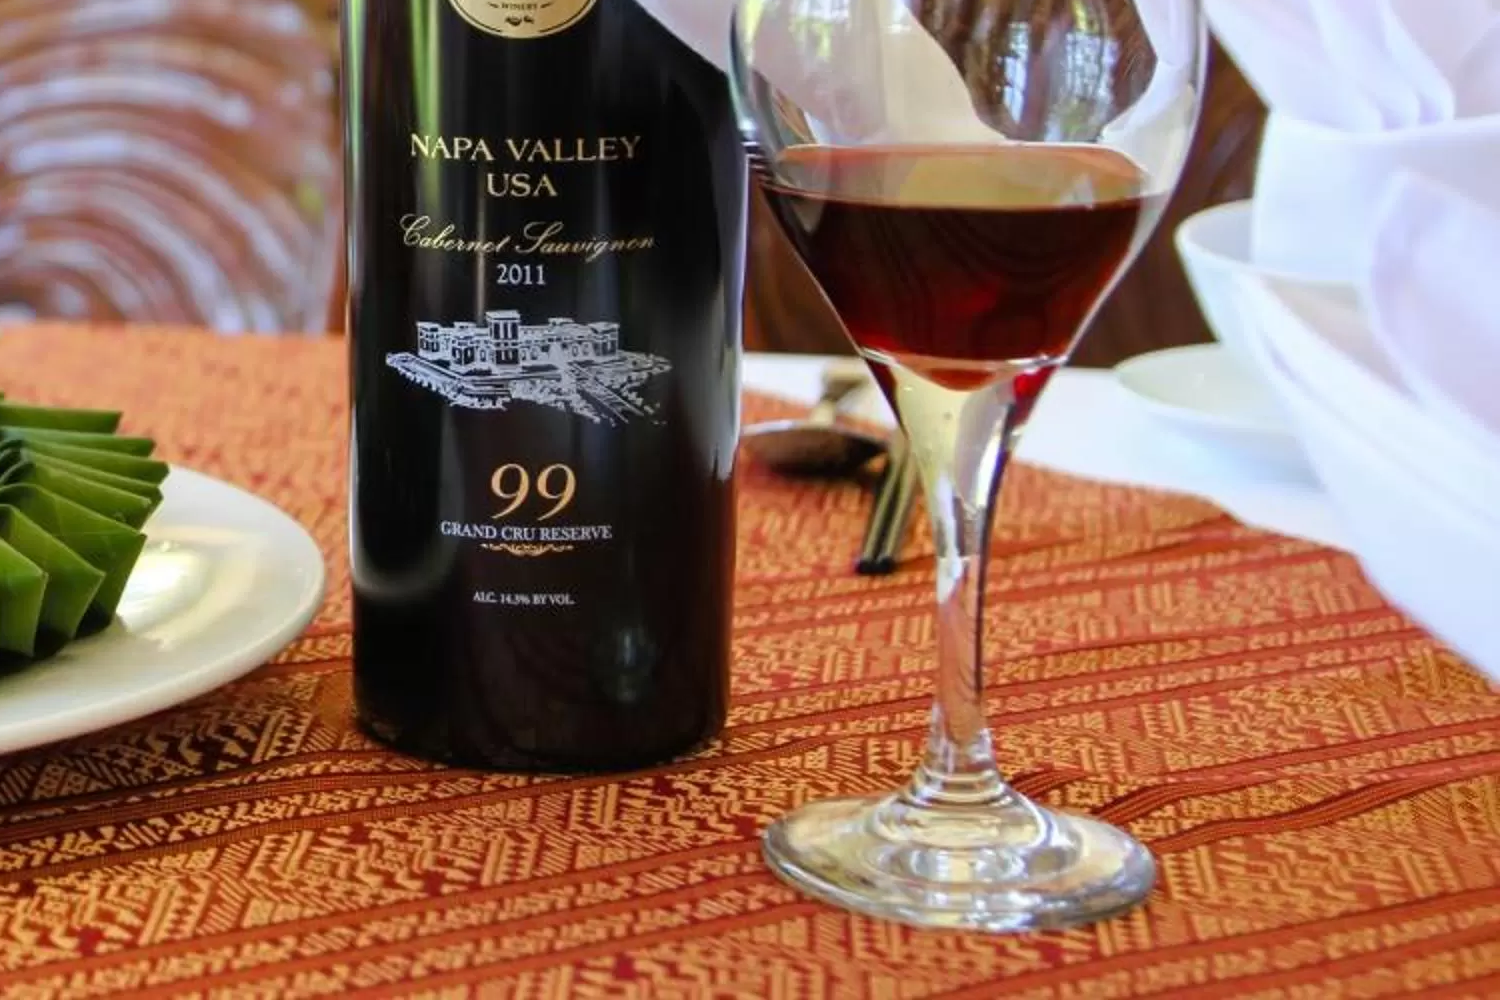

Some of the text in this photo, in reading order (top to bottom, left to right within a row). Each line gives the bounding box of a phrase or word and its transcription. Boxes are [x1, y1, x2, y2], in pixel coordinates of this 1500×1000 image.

[410, 133, 641, 162] NAPA VALLEY
[487, 173, 558, 197] USA
[400, 213, 655, 263] Cabernet Sauvignon
[496, 263, 547, 286] 2011
[490, 463, 577, 522] 99
[440, 521, 613, 541] GRAND CRU RESERVE
[532, 593, 549, 605] BY
